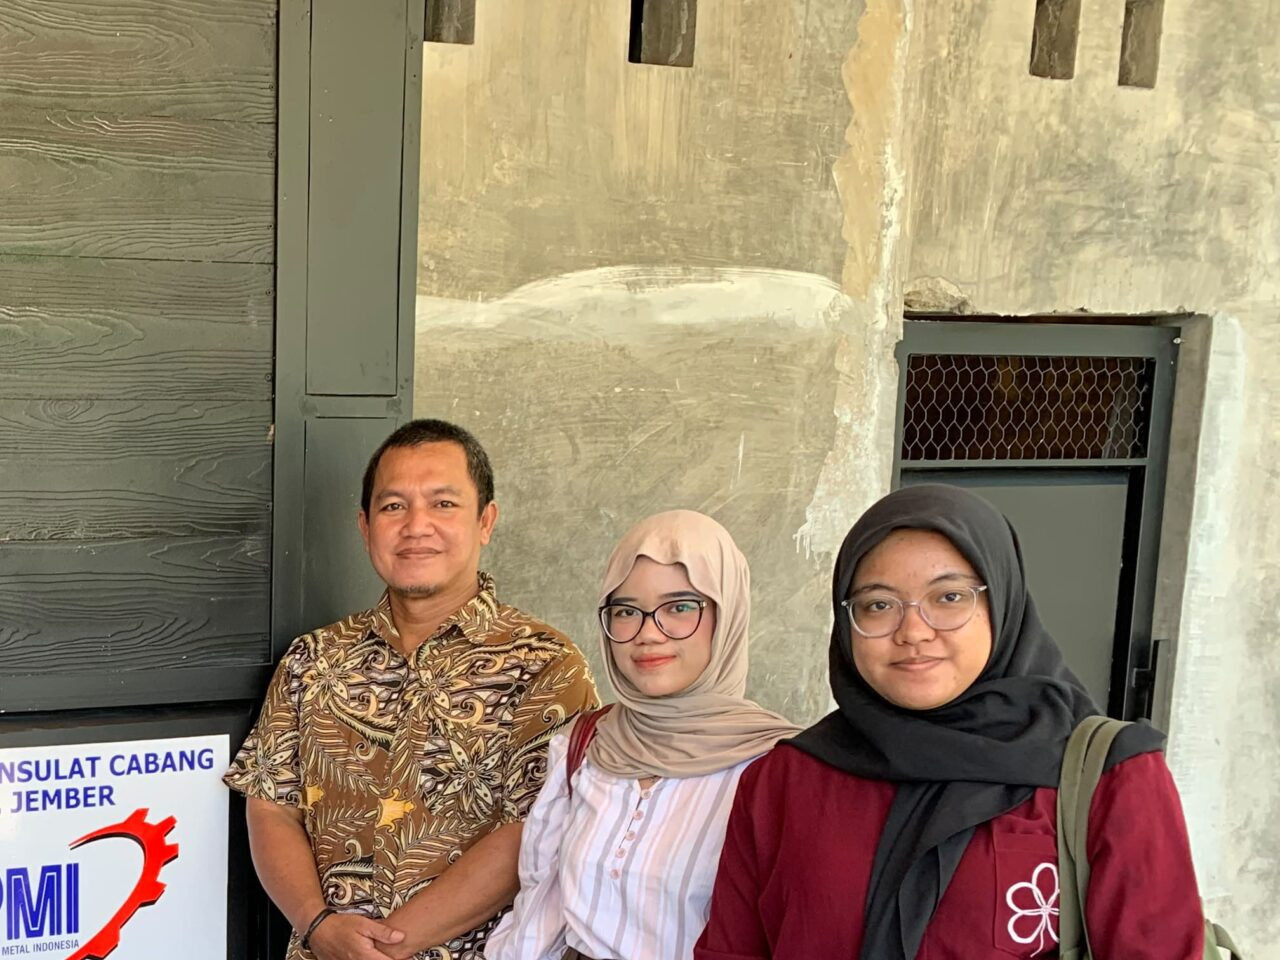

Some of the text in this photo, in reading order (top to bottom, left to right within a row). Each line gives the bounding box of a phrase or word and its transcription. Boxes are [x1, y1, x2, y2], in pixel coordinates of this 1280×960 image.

[109, 748, 214, 777] CABANG
[10, 785, 116, 814] JEMBER
[2, 943, 30, 956] METAL
[33, 938, 79, 953] INDONESIA
